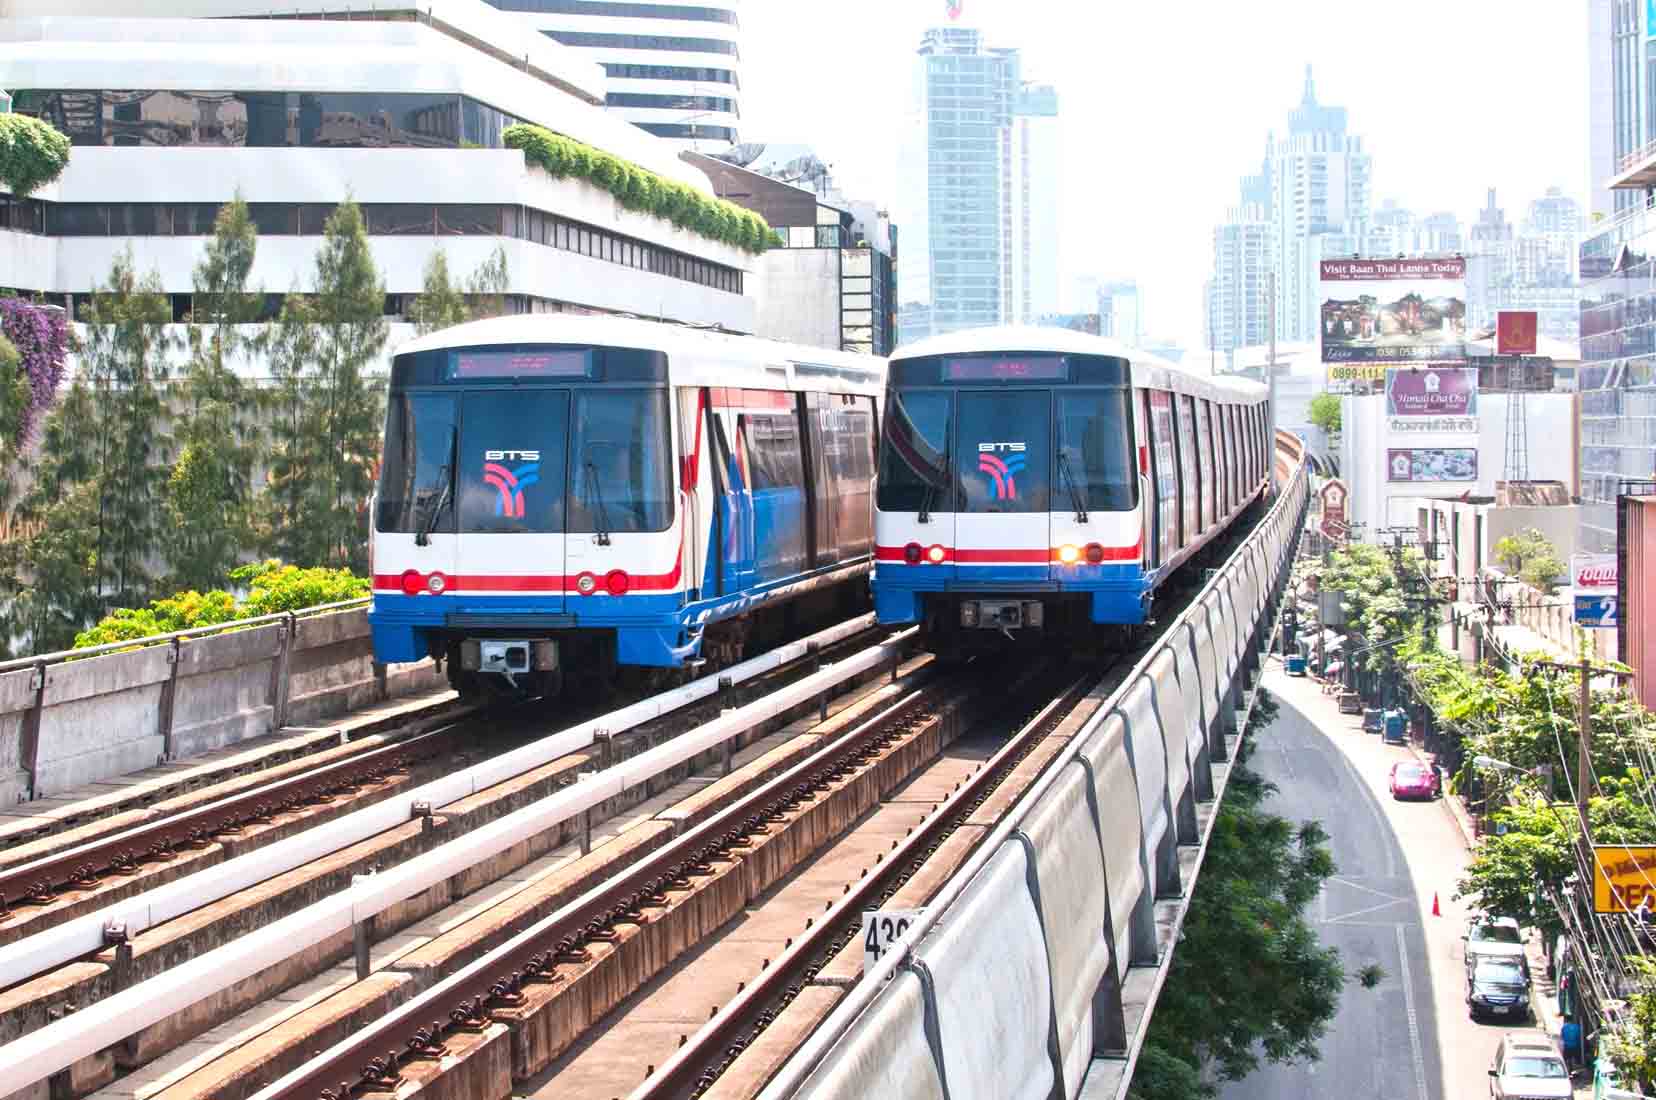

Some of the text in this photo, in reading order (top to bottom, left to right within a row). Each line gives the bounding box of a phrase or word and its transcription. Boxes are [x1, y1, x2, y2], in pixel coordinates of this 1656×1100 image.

[1324, 262, 1461, 275] Visit Baan Thai Lanna Today
[978, 442, 1026, 452] BTS
[485, 450, 540, 461] BTS
